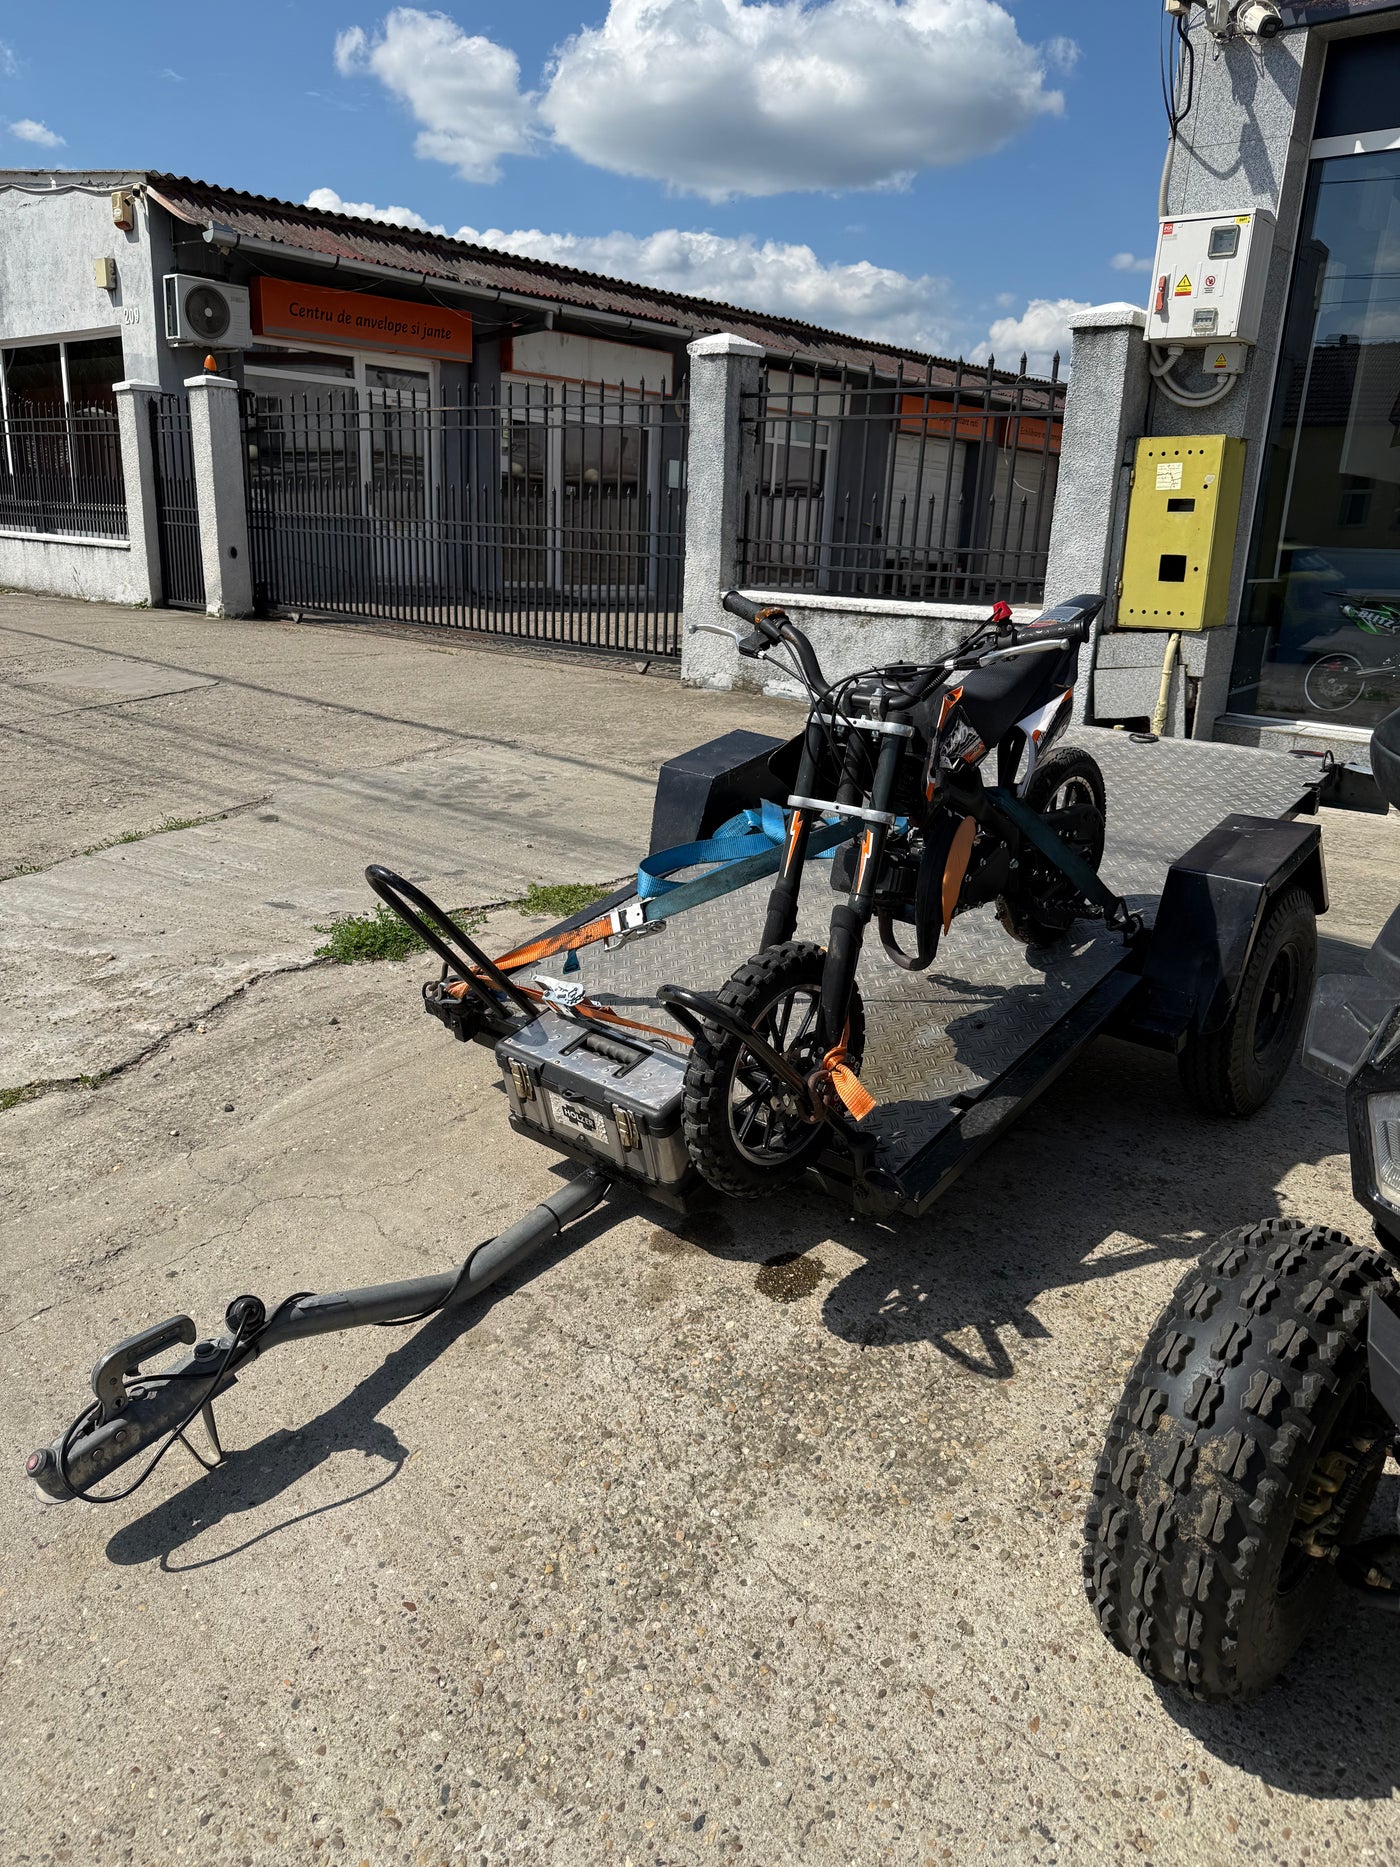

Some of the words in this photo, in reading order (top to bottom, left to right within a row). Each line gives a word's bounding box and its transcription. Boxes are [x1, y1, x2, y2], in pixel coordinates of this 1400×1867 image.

[123, 307, 140, 325] 209
[289, 302, 333, 321] Centru
[337, 309, 352, 325] de
[355, 315, 408, 336] anvelope
[411, 321, 420, 335] si
[420, 322, 452, 340] jante
[1358, 610, 1394, 628] BLITZ
[563, 1107, 595, 1128] HOLZER
